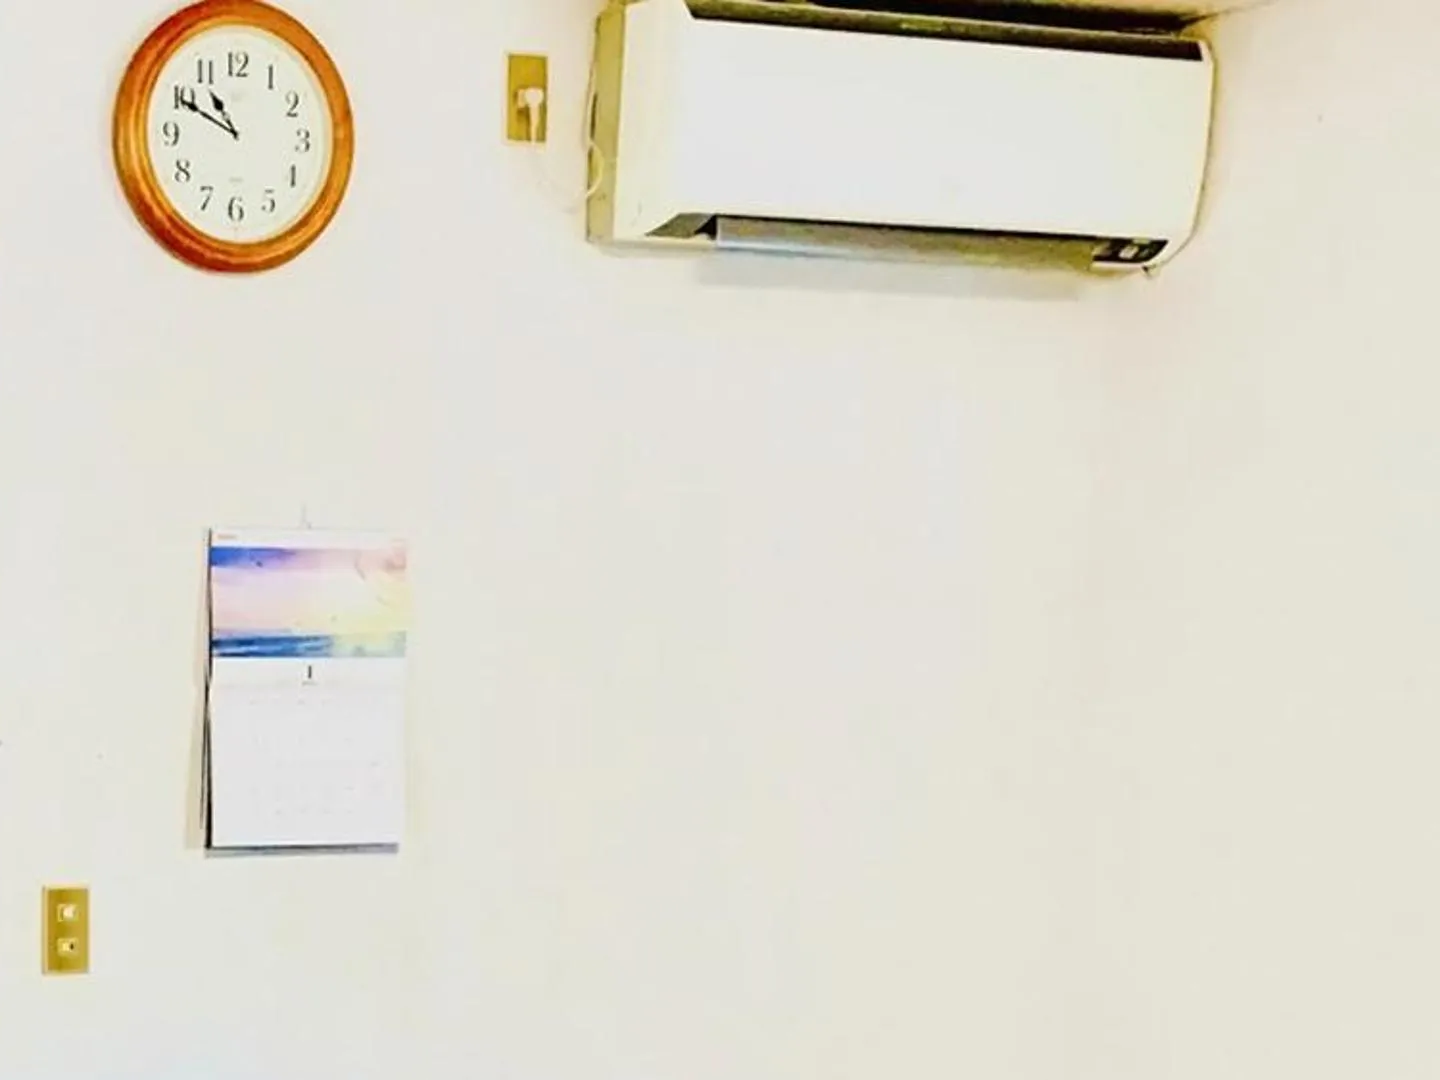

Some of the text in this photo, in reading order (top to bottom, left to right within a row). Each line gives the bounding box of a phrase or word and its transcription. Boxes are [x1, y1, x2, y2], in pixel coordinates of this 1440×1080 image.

[197, 58, 215, 85] 11
[227, 51, 250, 78] 12
[267, 63, 275, 90] 1
[173, 85, 196, 110] 10
[284, 91, 300, 118] 2
[162, 121, 180, 147] 9
[294, 128, 311, 153] 3
[174, 158, 191, 183] 8
[199, 185, 214, 212] 7
[227, 196, 245, 222] 6
[261, 188, 276, 213] 5
